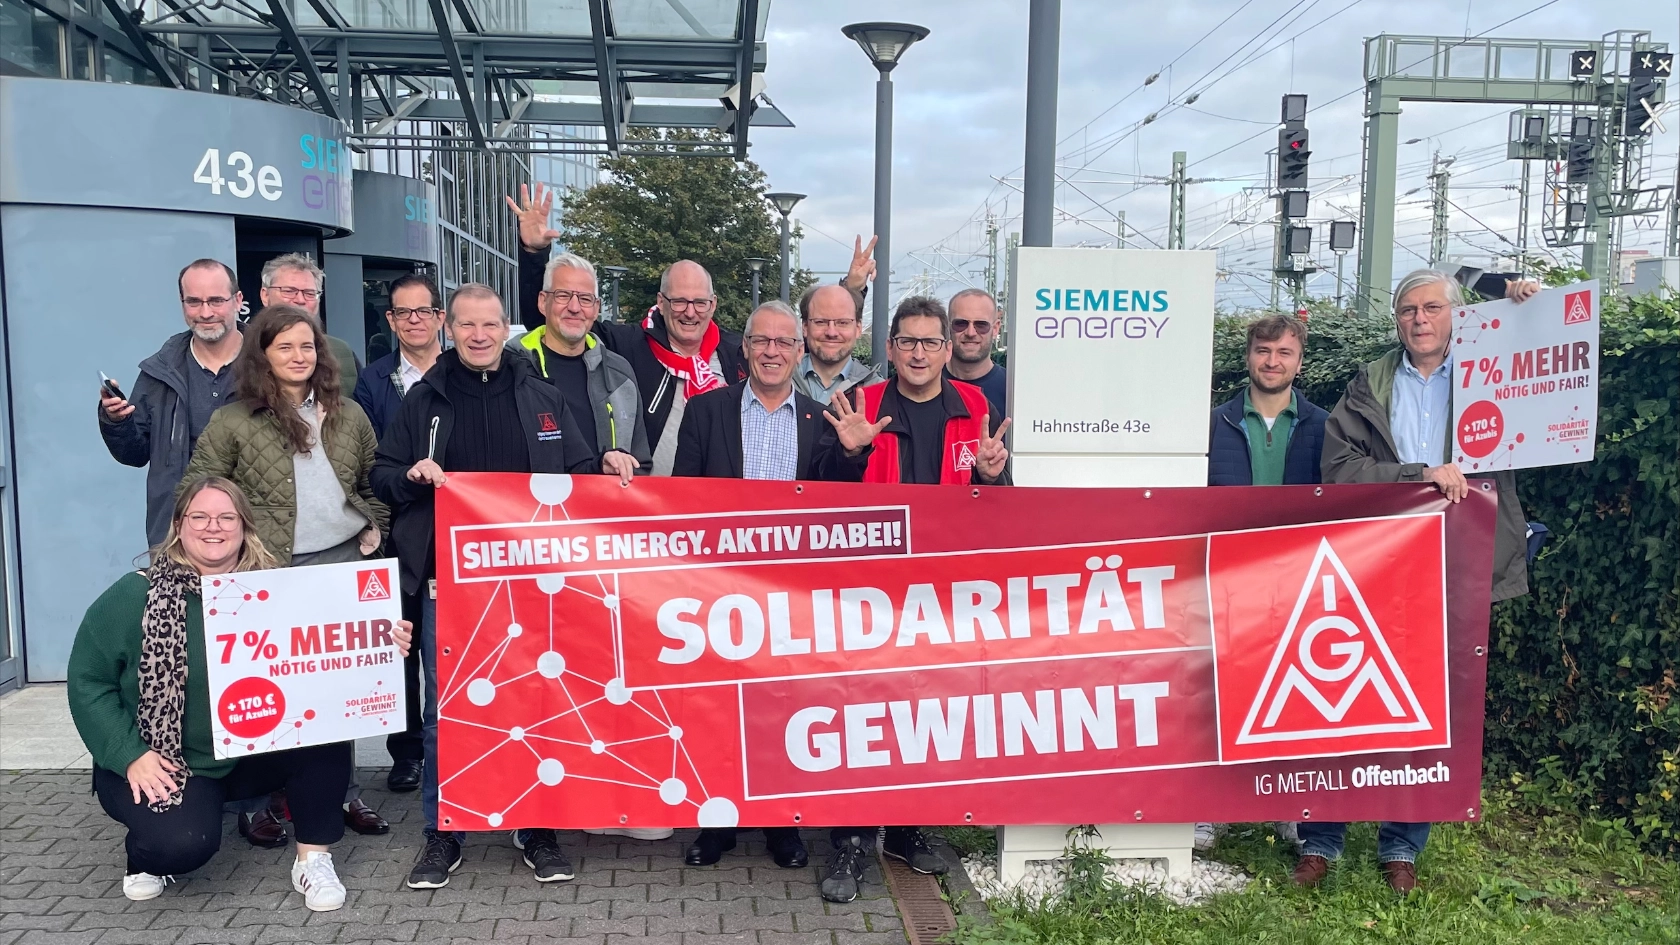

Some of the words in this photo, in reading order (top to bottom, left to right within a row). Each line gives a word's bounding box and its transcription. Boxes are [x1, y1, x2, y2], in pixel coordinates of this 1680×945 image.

[193, 148, 283, 201] 43e
[1035, 288, 1169, 312] SIEMENS
[1511, 341, 1590, 382] MEHR
[1494, 384, 1529, 401] NÖTIG
[1532, 380, 1556, 396] UND
[1559, 375, 1590, 392] FAIR!
[1032, 419, 1120, 433] Hahnstraße
[1123, 419, 1151, 433] 43e
[1463, 435, 1474, 444] für
[1475, 430, 1498, 443] Azubis
[1547, 418, 1589, 432] SOLIDARITÄT
[1559, 428, 1589, 438] GEWINNT
[462, 535, 590, 570] SIEMENS
[594, 529, 711, 562] ENERGY.
[716, 525, 803, 555] AKTIV
[808, 520, 902, 551] DABEI!
[655, 553, 1176, 665] SOLIDARITÄT
[290, 618, 394, 657] MEHR
[269, 660, 316, 677] NÖTIG
[320, 656, 351, 672] UND
[356, 650, 394, 668] FAIR!
[237, 698, 262, 712] 170
[345, 693, 397, 708] SOLIDARITÄT
[361, 701, 397, 713] GEWINNT
[228, 713, 243, 725] für
[245, 707, 277, 721] Azubis
[783, 680, 1170, 773] GEWINNT
[1254, 773, 1273, 795] IG
[1277, 769, 1349, 794] METALL
[1351, 761, 1450, 789] Offenbach
